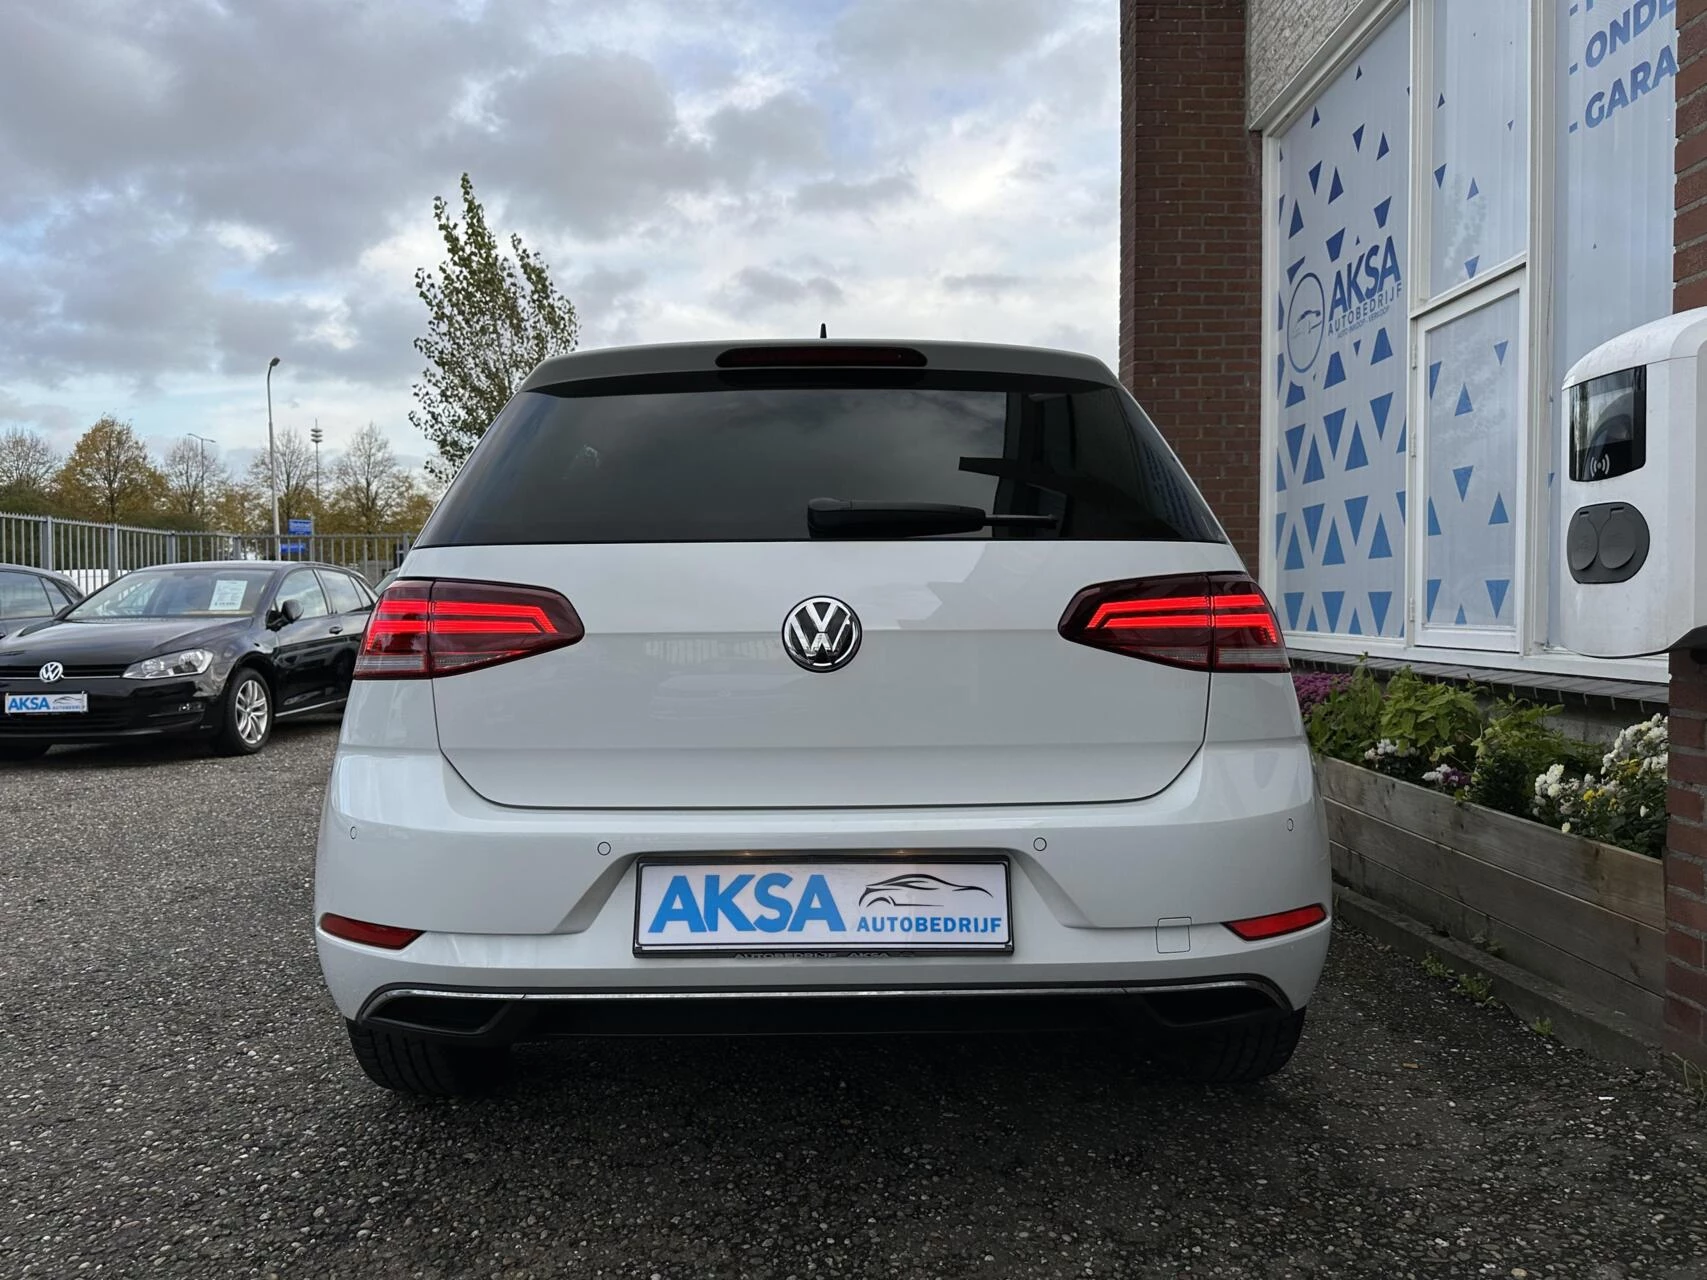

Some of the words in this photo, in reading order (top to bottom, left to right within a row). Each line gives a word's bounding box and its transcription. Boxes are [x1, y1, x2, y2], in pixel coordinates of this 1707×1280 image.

[1328, 235, 1402, 322] AKSA
[1328, 282, 1402, 337] AUTOBEDRIJF
[9, 697, 50, 710] AKSA
[648, 872, 847, 934] AKSA
[856, 915, 1003, 933] AUTOBEDRIJF
